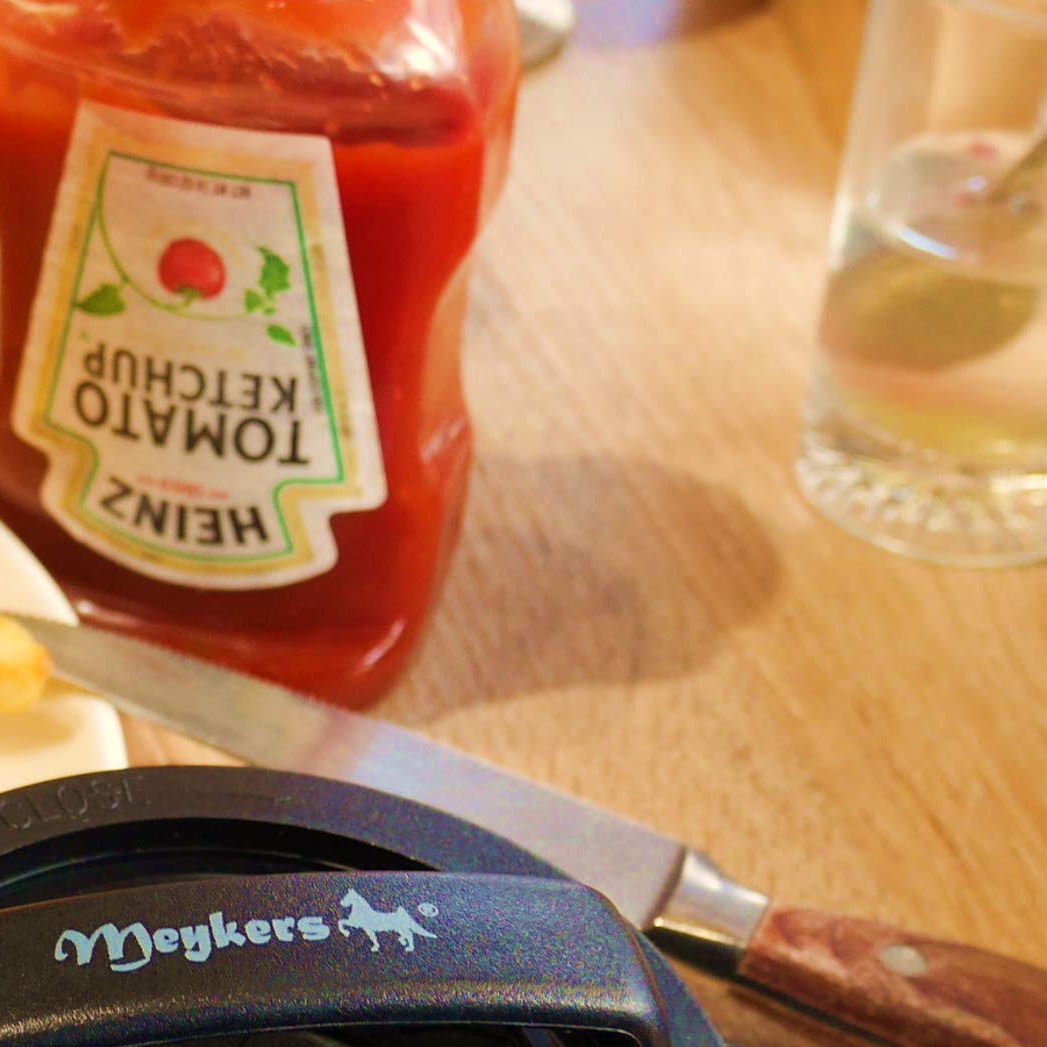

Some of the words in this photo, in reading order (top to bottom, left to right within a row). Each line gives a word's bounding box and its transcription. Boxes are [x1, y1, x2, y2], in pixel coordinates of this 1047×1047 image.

[82, 342, 298, 414] KETCHUP
[73, 380, 311, 465] TOMATO
[98, 475, 270, 546] HEINZ
[54, 911, 330, 973] Meykers
